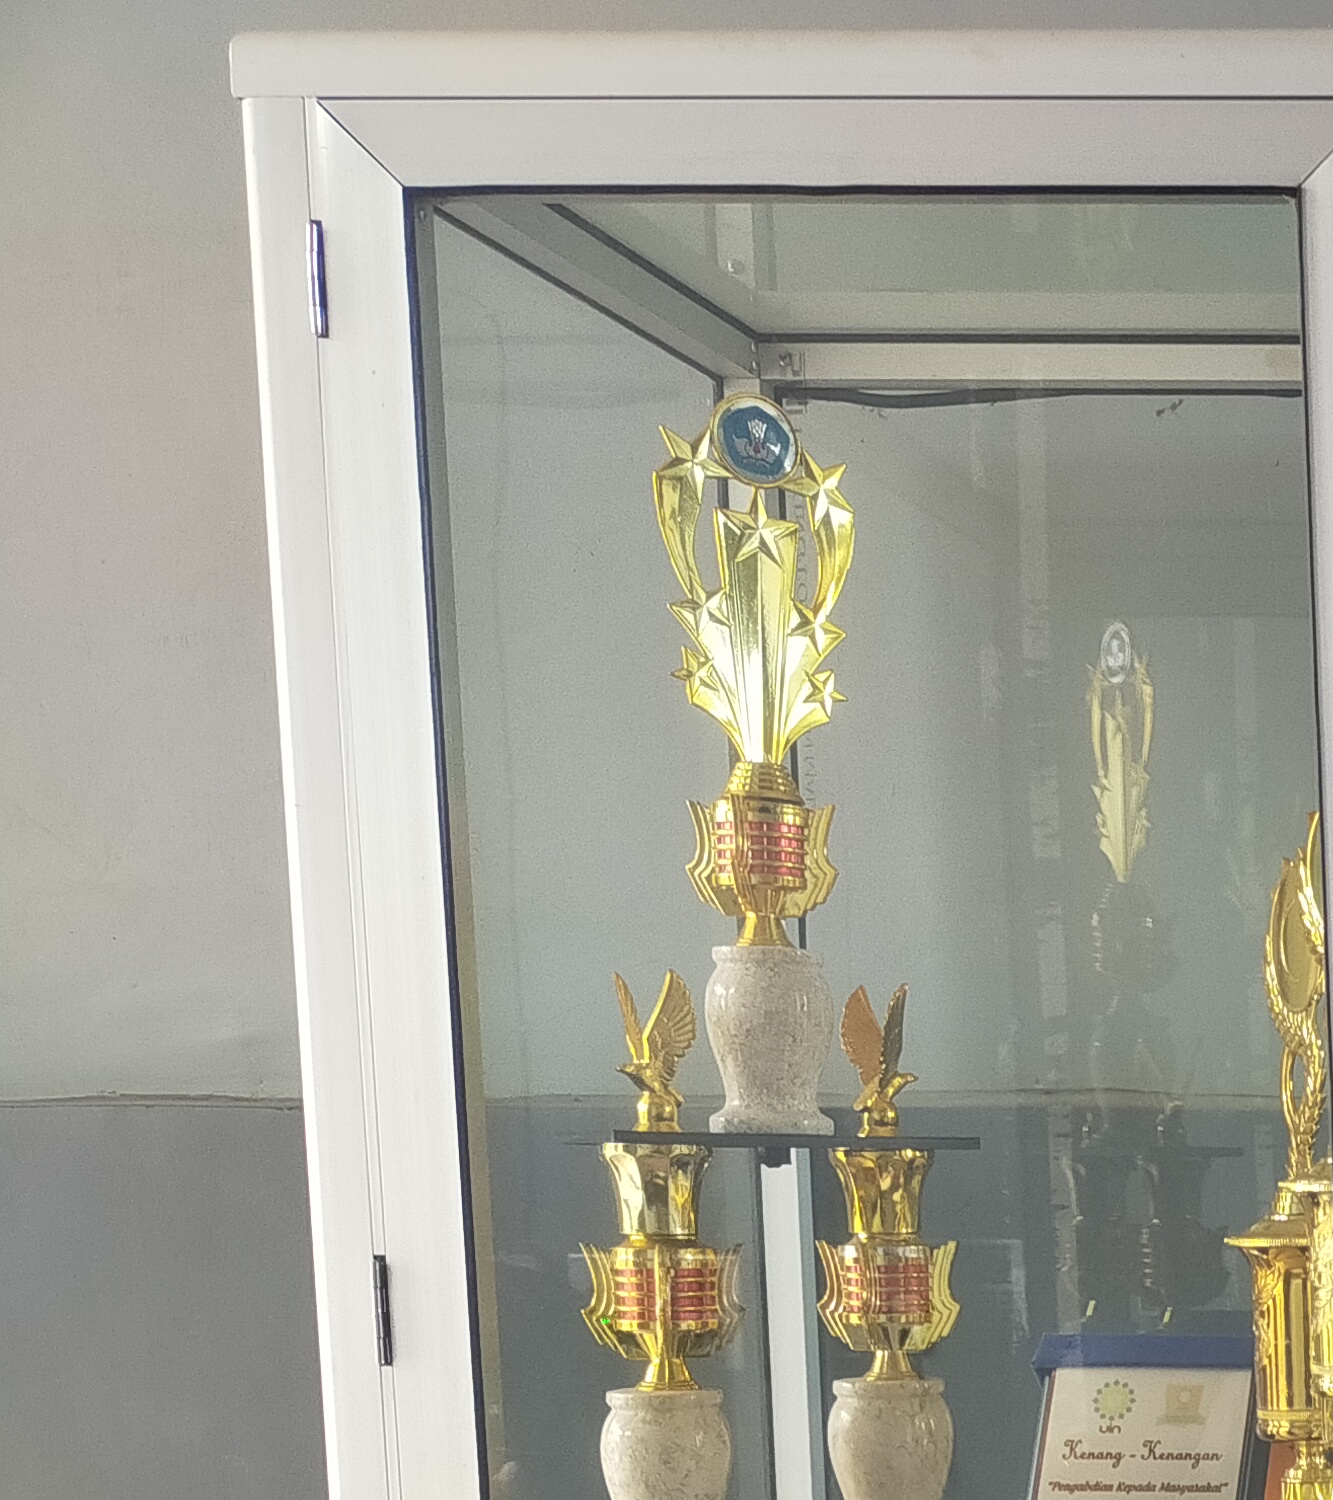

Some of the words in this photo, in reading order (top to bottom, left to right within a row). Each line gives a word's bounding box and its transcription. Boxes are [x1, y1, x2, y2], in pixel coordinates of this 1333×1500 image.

[1062, 1438, 1126, 1469] Kenang
[1140, 1439, 1223, 1470] Kenangan
[1115, 1481, 1157, 1496] Kepada
